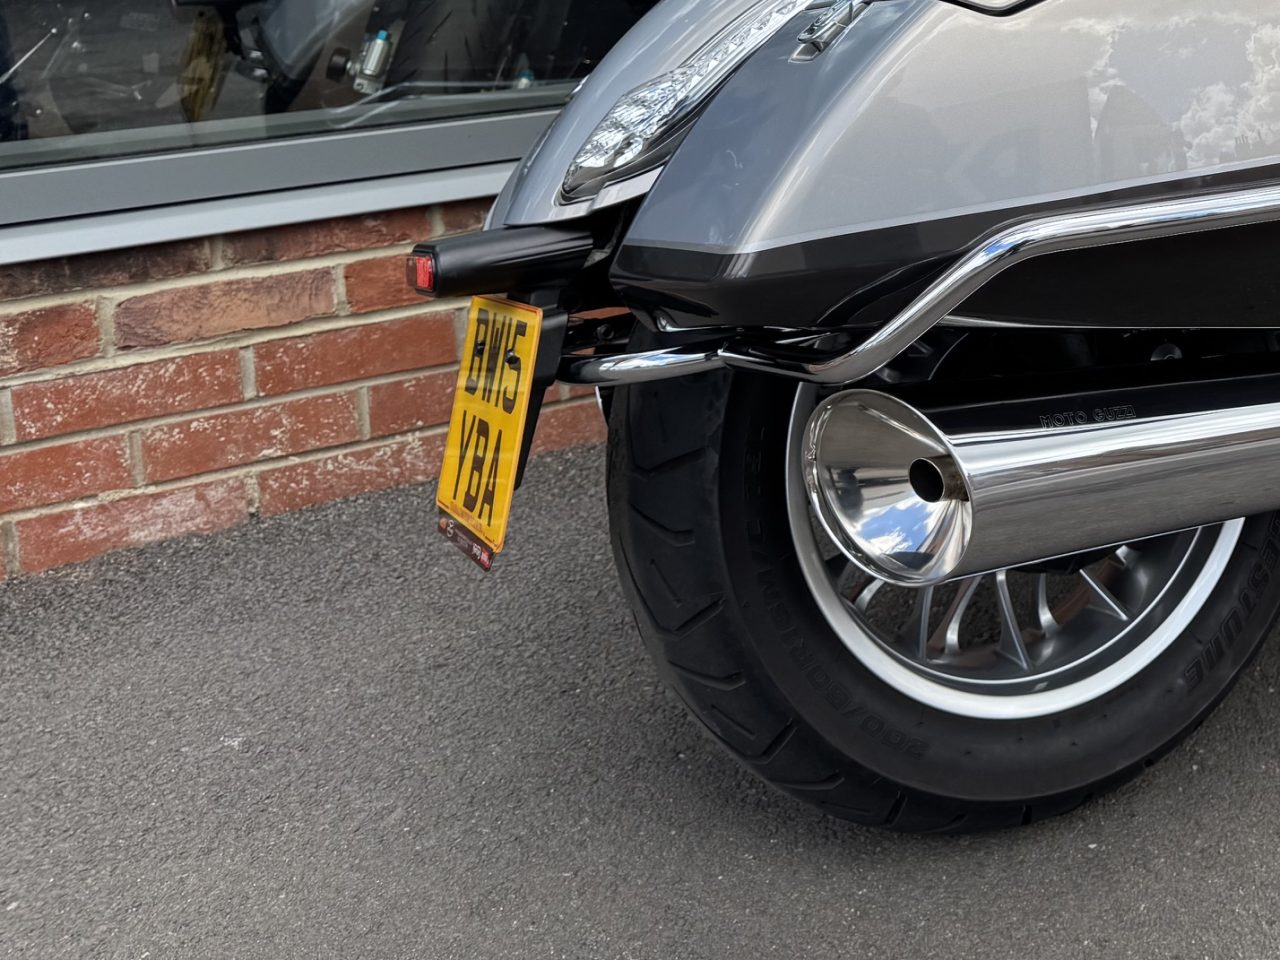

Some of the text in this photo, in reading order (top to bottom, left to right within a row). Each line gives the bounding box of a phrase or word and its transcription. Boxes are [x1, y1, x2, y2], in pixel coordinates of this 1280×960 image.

[464, 307, 528, 415] BW15
[453, 409, 503, 528] YBA
[1039, 404, 1137, 429] MOTO GUZZI
